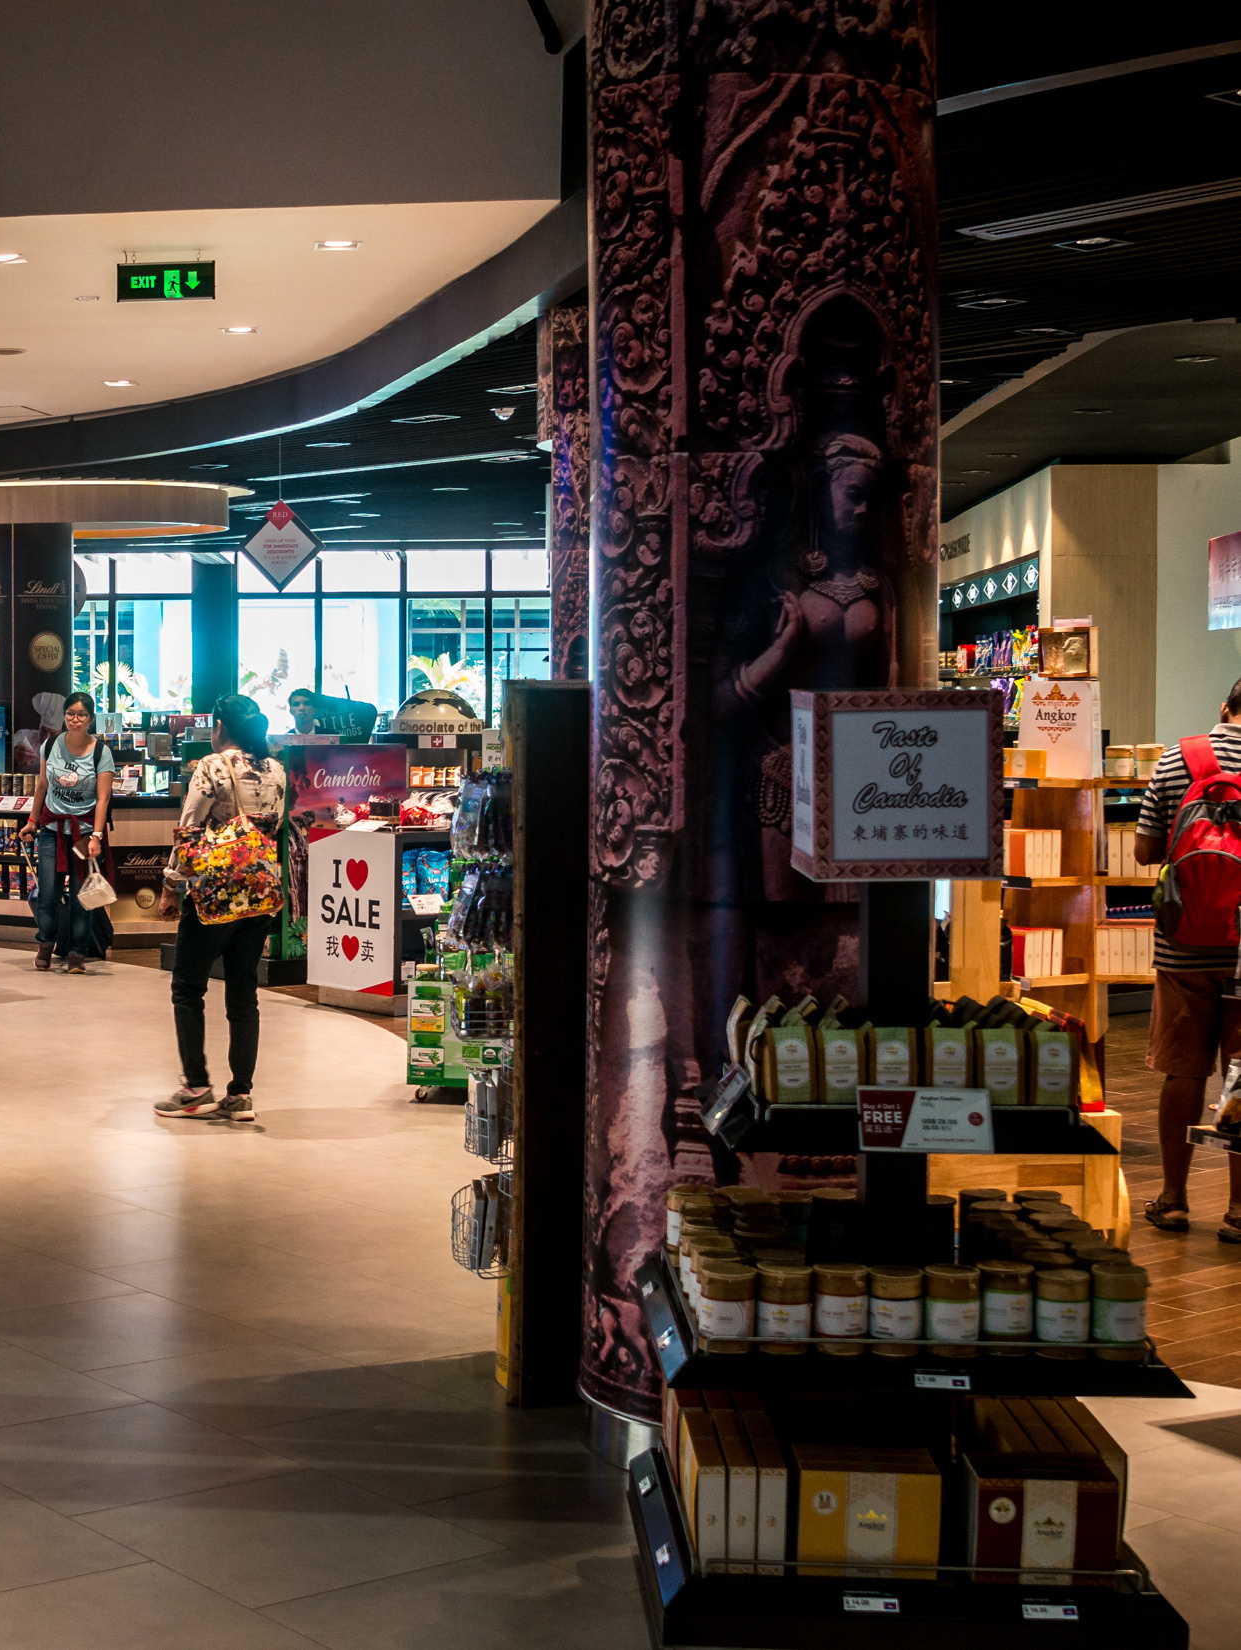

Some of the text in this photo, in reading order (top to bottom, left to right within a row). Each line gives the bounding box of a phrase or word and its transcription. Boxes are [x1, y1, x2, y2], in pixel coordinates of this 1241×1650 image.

[130, 276, 157, 288] EXIT
[399, 721, 481, 733] Chocolate of the
[1035, 708, 1077, 724] Angkor
[872, 721, 938, 749] Taste
[313, 766, 381, 789] Cambodia
[889, 752, 922, 785] Of
[852, 782, 969, 814] Cambodia
[123, 853, 159, 866] Lindt
[332, 858, 342, 889] I
[321, 893, 381, 930] SALE
[326, 935, 375, 962] 我 卖
[863, 1110, 903, 1123] FREE
